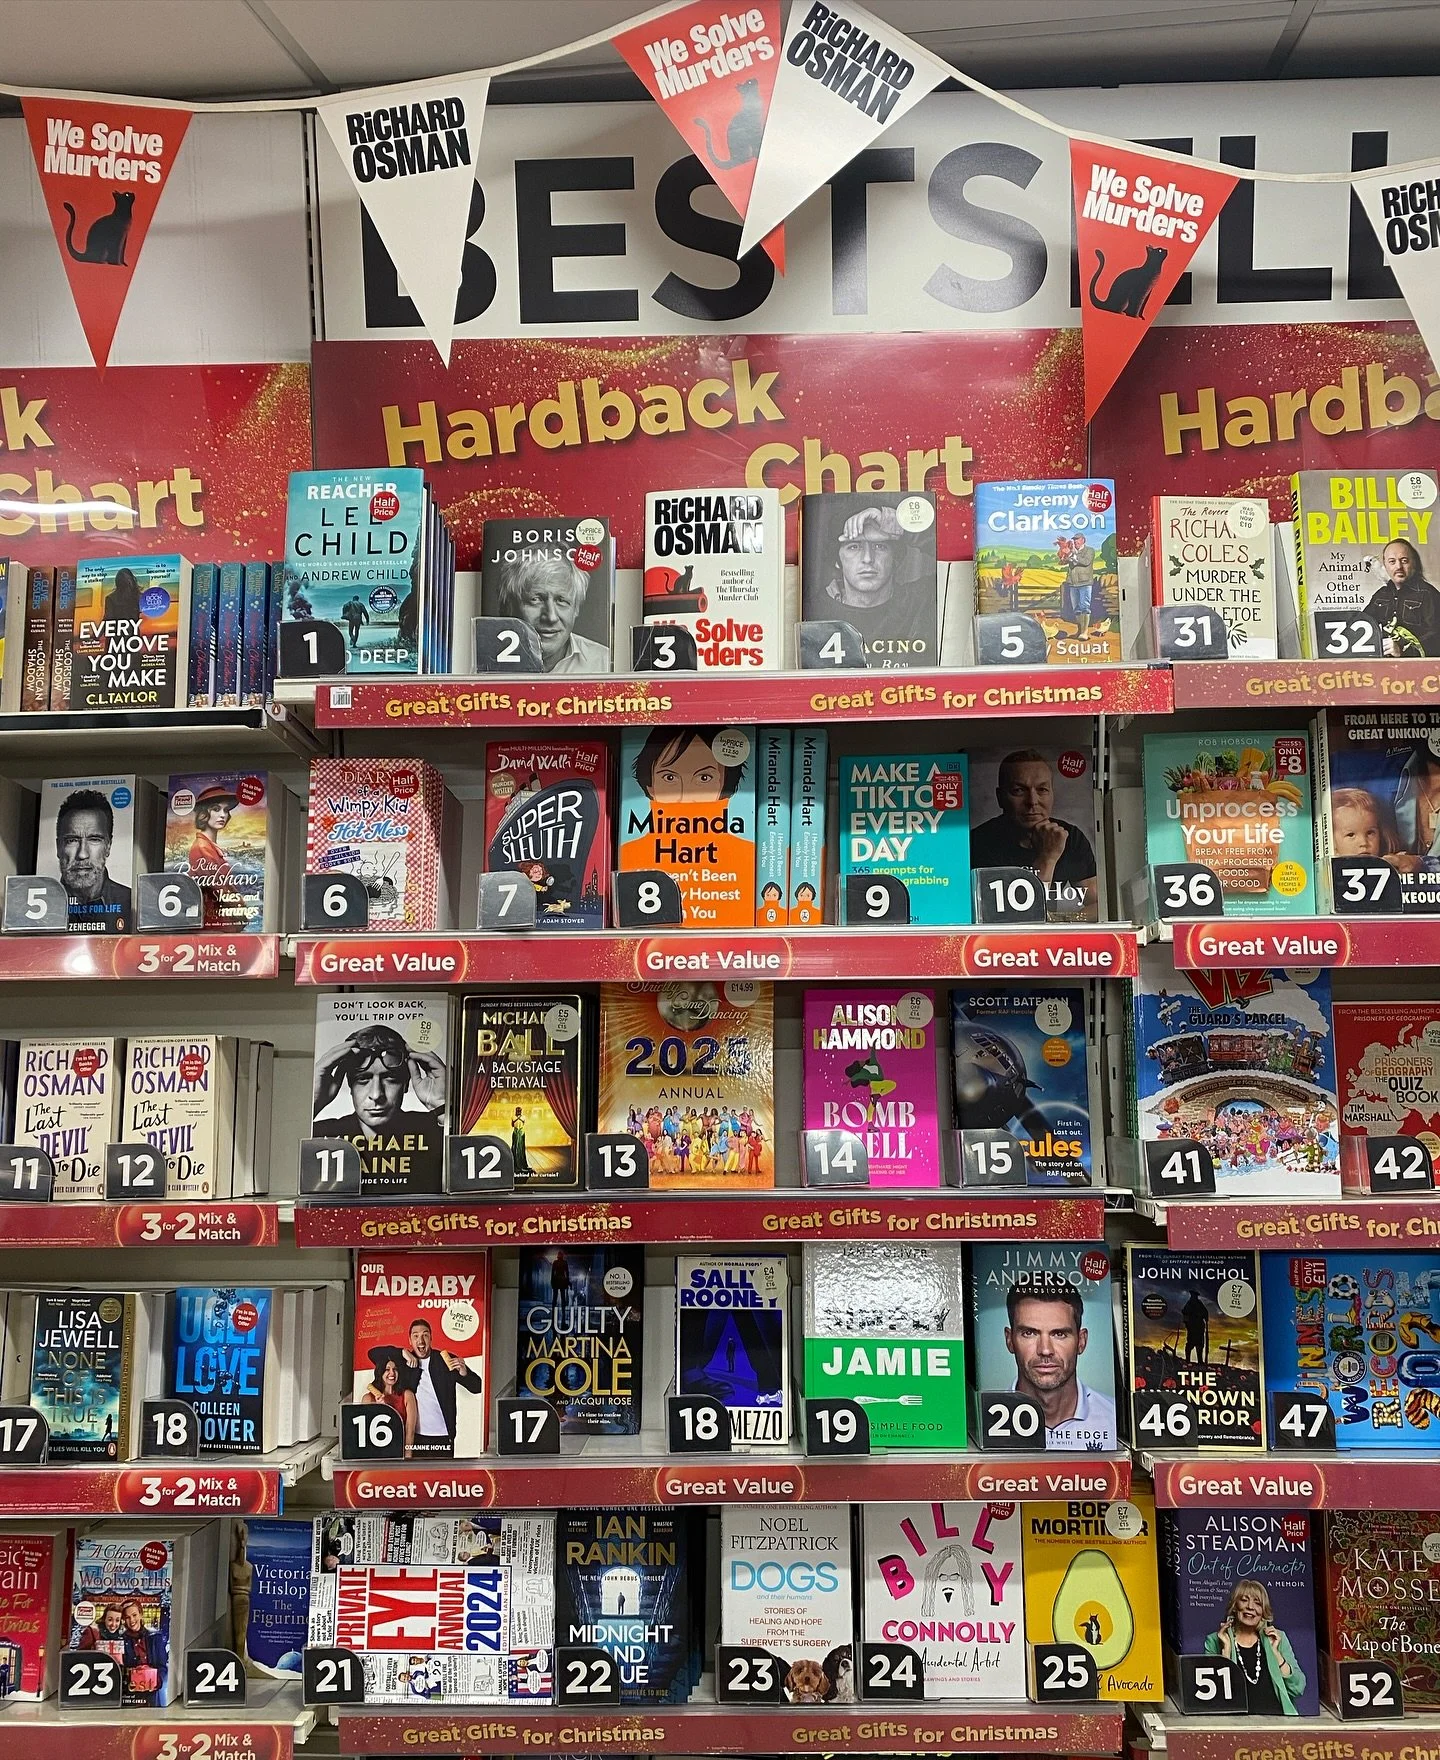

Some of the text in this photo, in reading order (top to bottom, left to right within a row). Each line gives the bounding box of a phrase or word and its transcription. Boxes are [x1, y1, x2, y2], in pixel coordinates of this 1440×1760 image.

[802, 1, 915, 90] RiCHARD
[786, 30, 901, 124] OSMAN
[346, 97, 466, 145] RiCHARD
[46, 118, 163, 157] We Solve
[43, 145, 162, 184] Murders
[352, 129, 472, 184] OSMAN
[381, 359, 785, 466] Hardback
[744, 435, 974, 507] Chart
[373, 498, 396, 507] Half
[1014, 494, 1078, 508] Jeremy
[1330, 477, 1406, 510] BILL
[654, 496, 764, 526] RiCHARD
[909, 501, 920, 510] £8
[987, 510, 1105, 531] Clarkson
[1307, 512, 1432, 544] BAILEY
[295, 531, 408, 557] CHILD
[513, 529, 575, 544] BORIS
[654, 523, 763, 556] OSMAN
[1182, 544, 1249, 564] COLES
[1331, 552, 1346, 562] My
[301, 570, 360, 581] ANDREW
[367, 569, 408, 579] CHILD
[721, 569, 754, 578] Bestselling
[1186, 570, 1248, 584] MURDER
[1319, 562, 1370, 573] Animals
[730, 586, 759, 594] Thursday
[1172, 588, 1261, 603] UNDER THE
[1326, 582, 1360, 592] Other
[1314, 594, 1364, 604] Animals
[80, 619, 142, 639] EVERY
[1324, 621, 1376, 654] 32
[108, 635, 170, 654] MOVE
[26, 648, 36, 692] SHADOW
[88, 654, 131, 671] YOU
[36, 652, 46, 700] CORSICAN
[108, 669, 166, 688] MAKE
[86, 691, 157, 704] C.L.TAYLOR
[386, 692, 672, 717] Great Gifts for Christmas
[1279, 756, 1300, 774] £8
[358, 787, 369, 796] of
[327, 797, 409, 818] Wimpy Kid
[501, 789, 583, 846] SUPER
[1166, 799, 1298, 820] Unprocess
[328, 820, 409, 841] Hot Mess
[628, 809, 745, 834] Miranda
[851, 811, 944, 834] EVERY
[502, 820, 583, 864] SLEUTH
[1181, 823, 1285, 844] Your Life
[655, 839, 718, 864] Hart
[852, 837, 912, 862] DAY
[1044, 881, 1088, 906] Hoy
[138, 944, 236, 973] 3 for 2 Mix &
[197, 960, 240, 972] Match
[647, 951, 780, 970] Great Value
[731, 983, 753, 992] £14.99
[334, 1001, 426, 1010] DON'T LOOK BACK,
[477, 1028, 565, 1056] BALL
[813, 1028, 926, 1050] HAMMOND
[478, 1061, 562, 1073] A BACKSTAGE
[490, 1076, 547, 1088] BETRAYAL
[1388, 1076, 1423, 1091] QUIZ
[658, 1087, 724, 1099] ANNUAL
[1396, 1090, 1438, 1104] BOOK
[132, 1103, 173, 1131] Last
[141, 1101, 158, 1113] The
[823, 1101, 916, 1128] BOMB
[1344, 1112, 1392, 1122] MARSHALL
[1350, 1104, 1365, 1112] TIM
[1138, 1268, 1250, 1280] JOHN NICHOL
[360, 1275, 476, 1296] LADBABY
[58, 1310, 102, 1330] LISA
[526, 1306, 632, 1334] GUILTY
[38, 1330, 119, 1349] JEWELL
[526, 1336, 632, 1359] MARTINA
[822, 1347, 951, 1377] JAMIE
[525, 1358, 632, 1396] COLE
[570, 1398, 605, 1406] JACQUI
[608, 1397, 632, 1405] ROSE
[1279, 1404, 1328, 1438] 47
[596, 1516, 645, 1539] IAN
[760, 1517, 809, 1532] NOEL
[731, 1536, 839, 1550] FITZPATRICK
[566, 1542, 676, 1566] RANKIN
[1355, 1548, 1428, 1572] KATE
[731, 1560, 839, 1592] DOGS
[1187, 1552, 1306, 1580] Out of Character
[258, 1580, 307, 1600] Hislop
[336, 1568, 368, 1650] PRIVATE
[367, 1568, 438, 1650] EYE
[438, 1570, 465, 1650] ANNUAL
[466, 1569, 502, 1651] 2024
[569, 1625, 674, 1643] MIDNIGHT
[881, 1620, 1016, 1644] CONNOLLY
[793, 1639, 831, 1648] SURGERY
[971, 1648, 1000, 1673] Artist
[1107, 1673, 1154, 1692] Avocado
